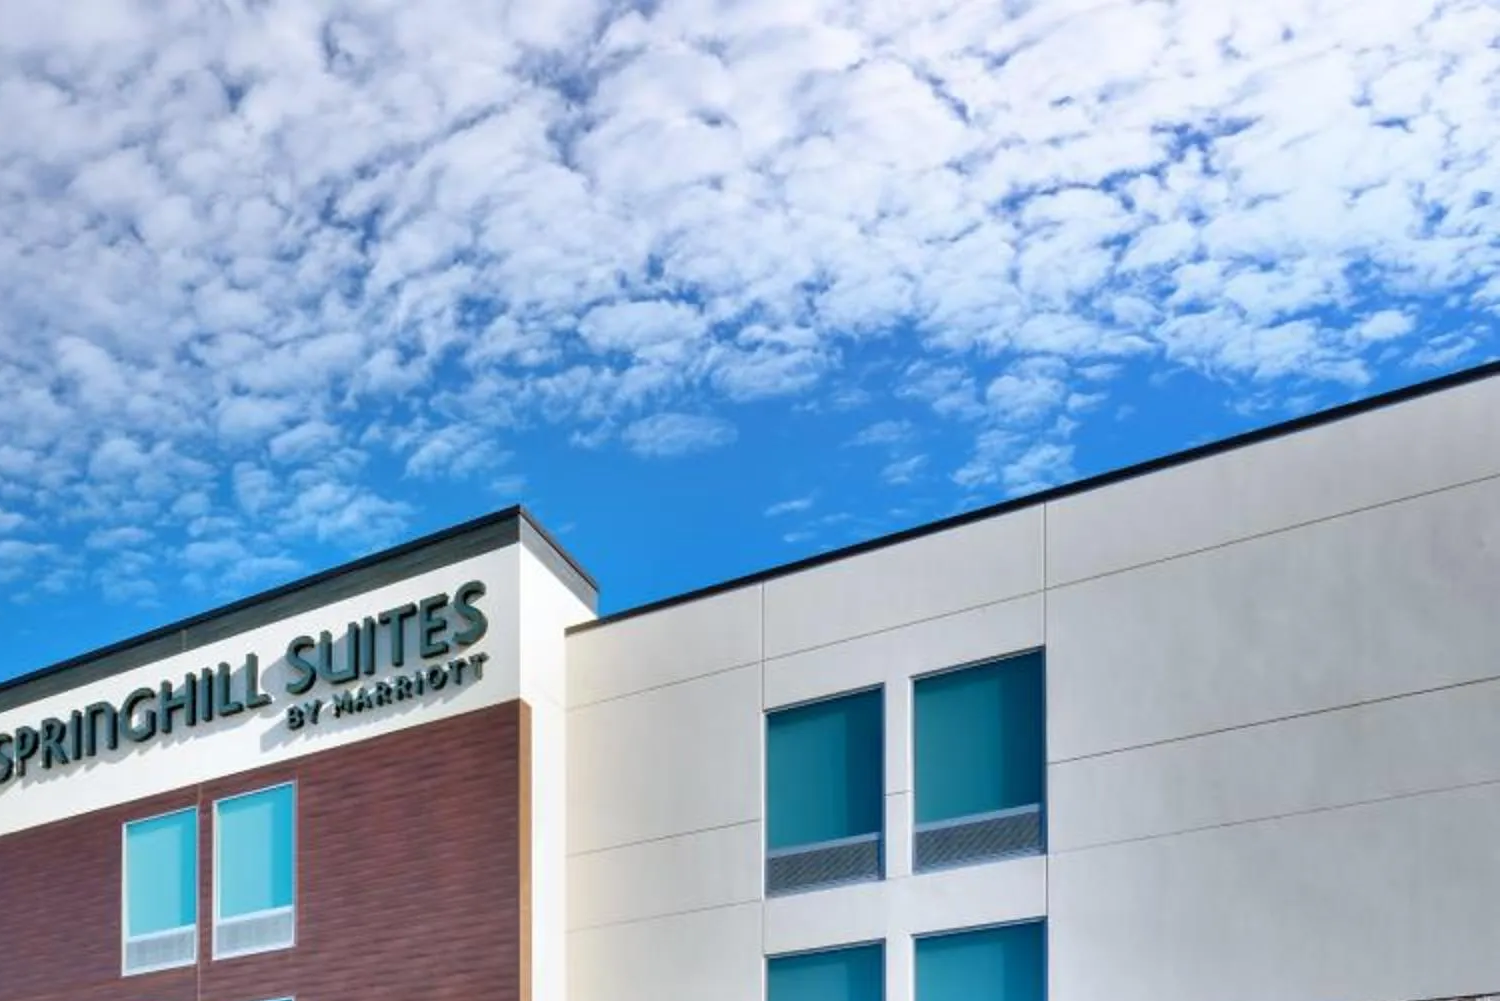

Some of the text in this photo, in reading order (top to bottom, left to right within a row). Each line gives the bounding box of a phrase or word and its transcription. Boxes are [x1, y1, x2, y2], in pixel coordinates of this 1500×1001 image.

[286, 579, 489, 695] SUITES
[287, 652, 490, 730] BY MARRIOTT
